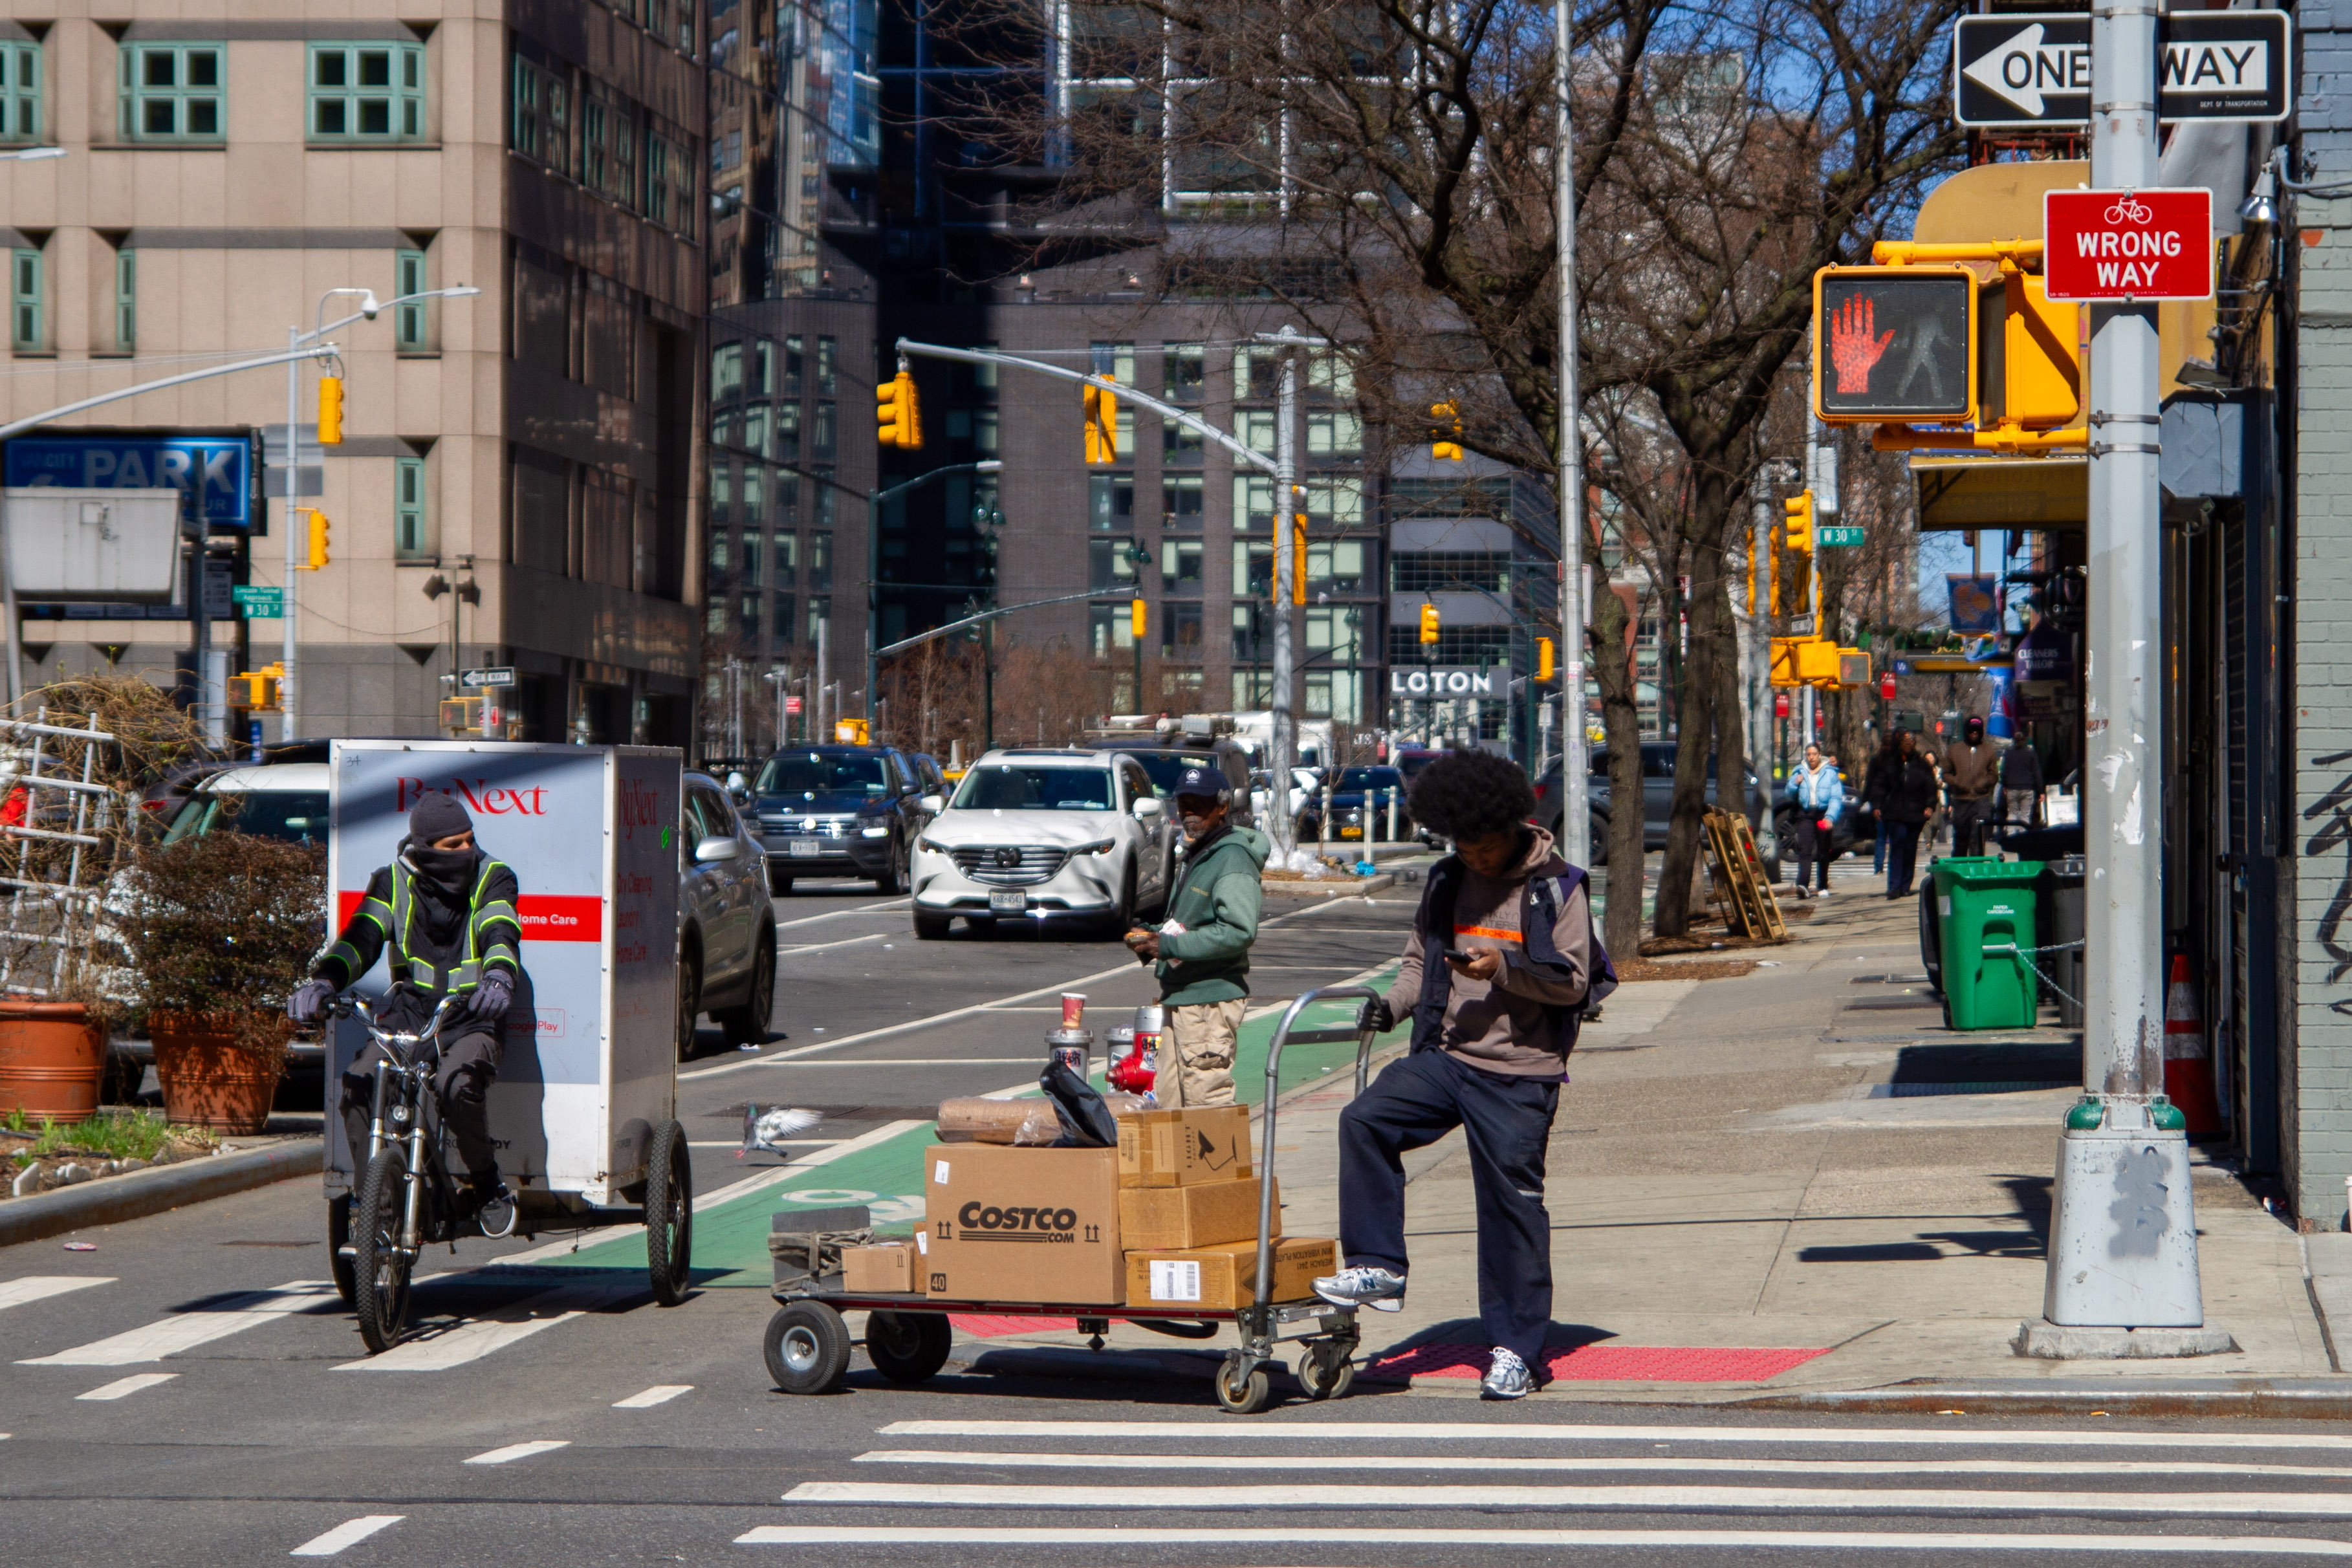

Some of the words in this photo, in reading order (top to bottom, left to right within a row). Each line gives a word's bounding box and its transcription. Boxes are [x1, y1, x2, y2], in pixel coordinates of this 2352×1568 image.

[2003, 50, 2091, 89] ONE
[2159, 46, 2256, 87] WAY
[2076, 230, 2181, 257] WRONG
[2096, 261, 2160, 288] WAY
[84, 449, 235, 492] PARK
[1824, 529, 1832, 541] W
[1835, 529, 1847, 542] 30
[246, 604, 254, 615] W
[257, 604, 269, 616] 30
[2018, 648, 2059, 659] CLEANERS
[2024, 660, 2054, 670] TAILOR
[1391, 671, 1492, 693] LOTON
[345, 755, 360, 767] 34
[395, 776, 549, 815] BNext
[618, 778, 658, 840] ByNext
[550, 914, 578, 926] Care
[1481, 929, 1518, 940] SCHOOL
[505, 1021, 536, 1033] oogle
[538, 1021, 558, 1033] Play
[958, 1201, 1076, 1230] COSTCO
[1043, 1232, 1074, 1243] .COM
[1274, 1252, 1292, 1262] PLATE
[1292, 1248, 1320, 1259] VIBRATION
[1310, 1258, 1333, 1268] MERACH
[931, 1276, 946, 1290] 40
[1361, 1278, 1376, 1290] N
